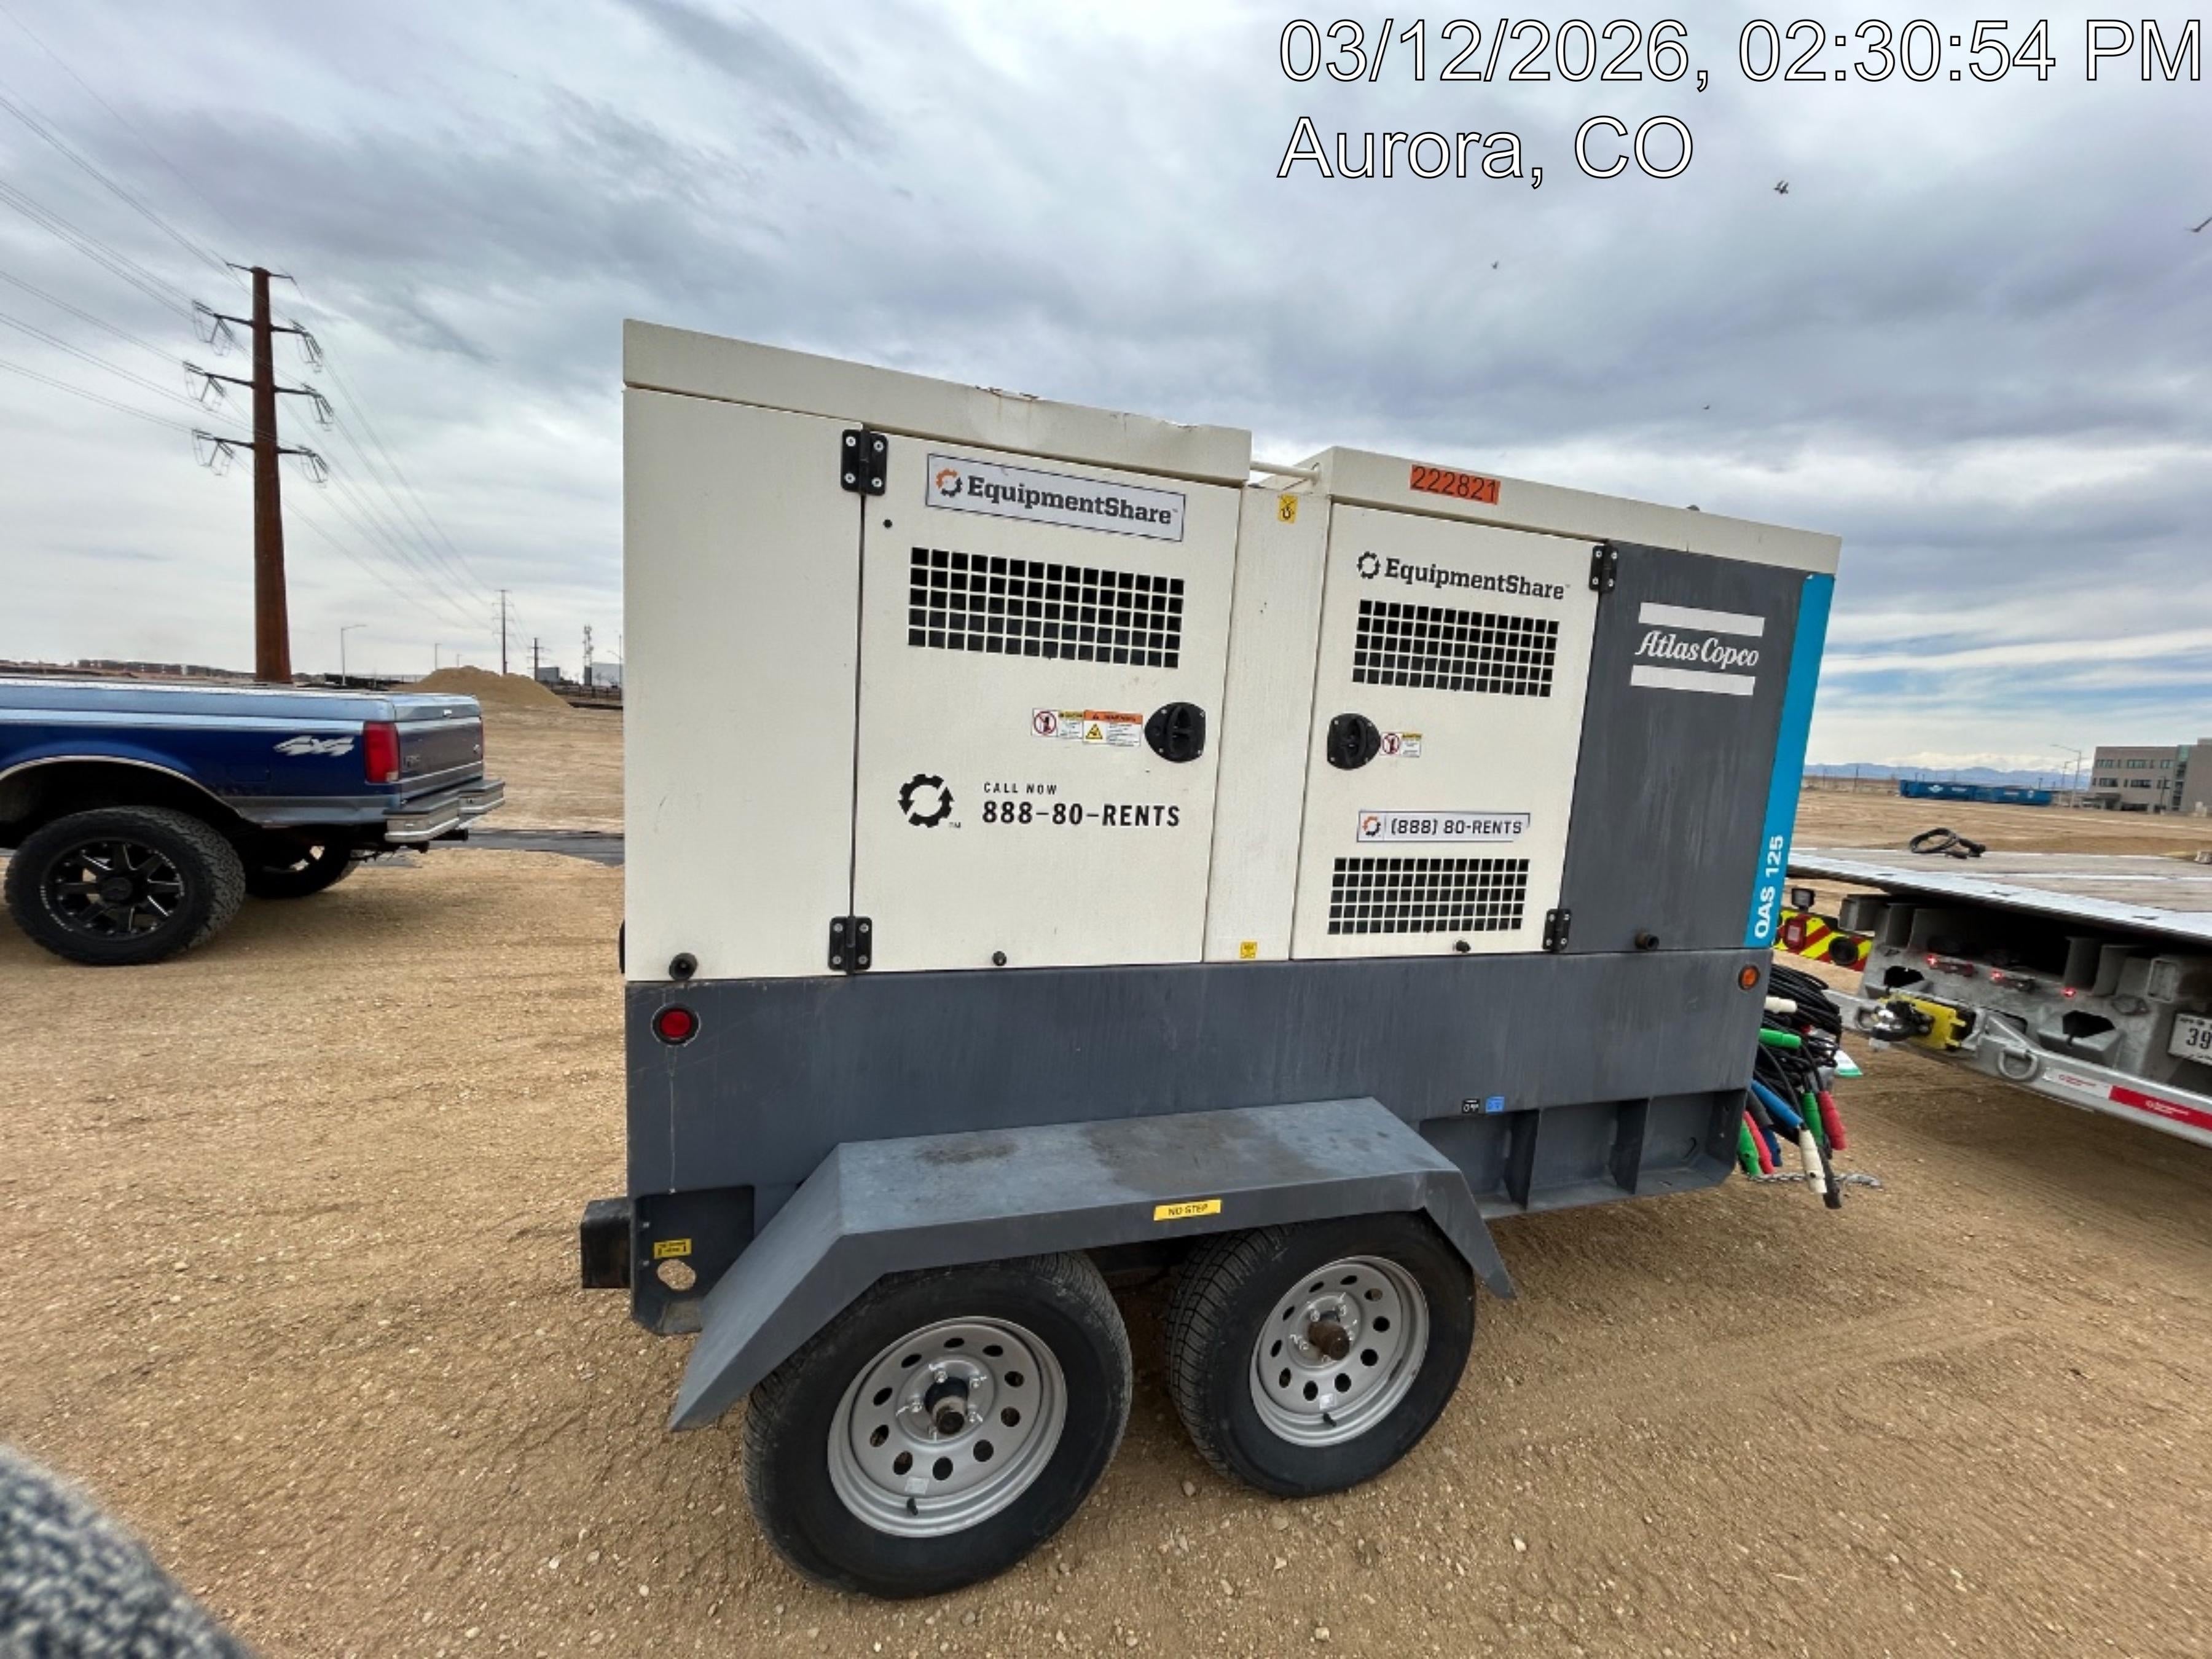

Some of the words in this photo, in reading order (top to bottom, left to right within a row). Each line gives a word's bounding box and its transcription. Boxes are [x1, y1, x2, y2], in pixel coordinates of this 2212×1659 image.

[1411, 466, 1496, 502] 222821
[967, 475, 1172, 525] EquipmentShare
[1385, 557, 1564, 600] EquipmentShare
[983, 782, 1019, 794] CALL
[1026, 783, 1057, 795] NOW
[982, 801, 1180, 827] 888-80-RENTS
[1390, 818, 1438, 835] (888)
[1443, 820, 1523, 835] 80-RENTS
[1765, 834, 1784, 879] 125
[2186, 1027, 2212, 1049] 39
[1168, 1207, 1182, 1216] NO
[1184, 1203, 1208, 1214] STEP
